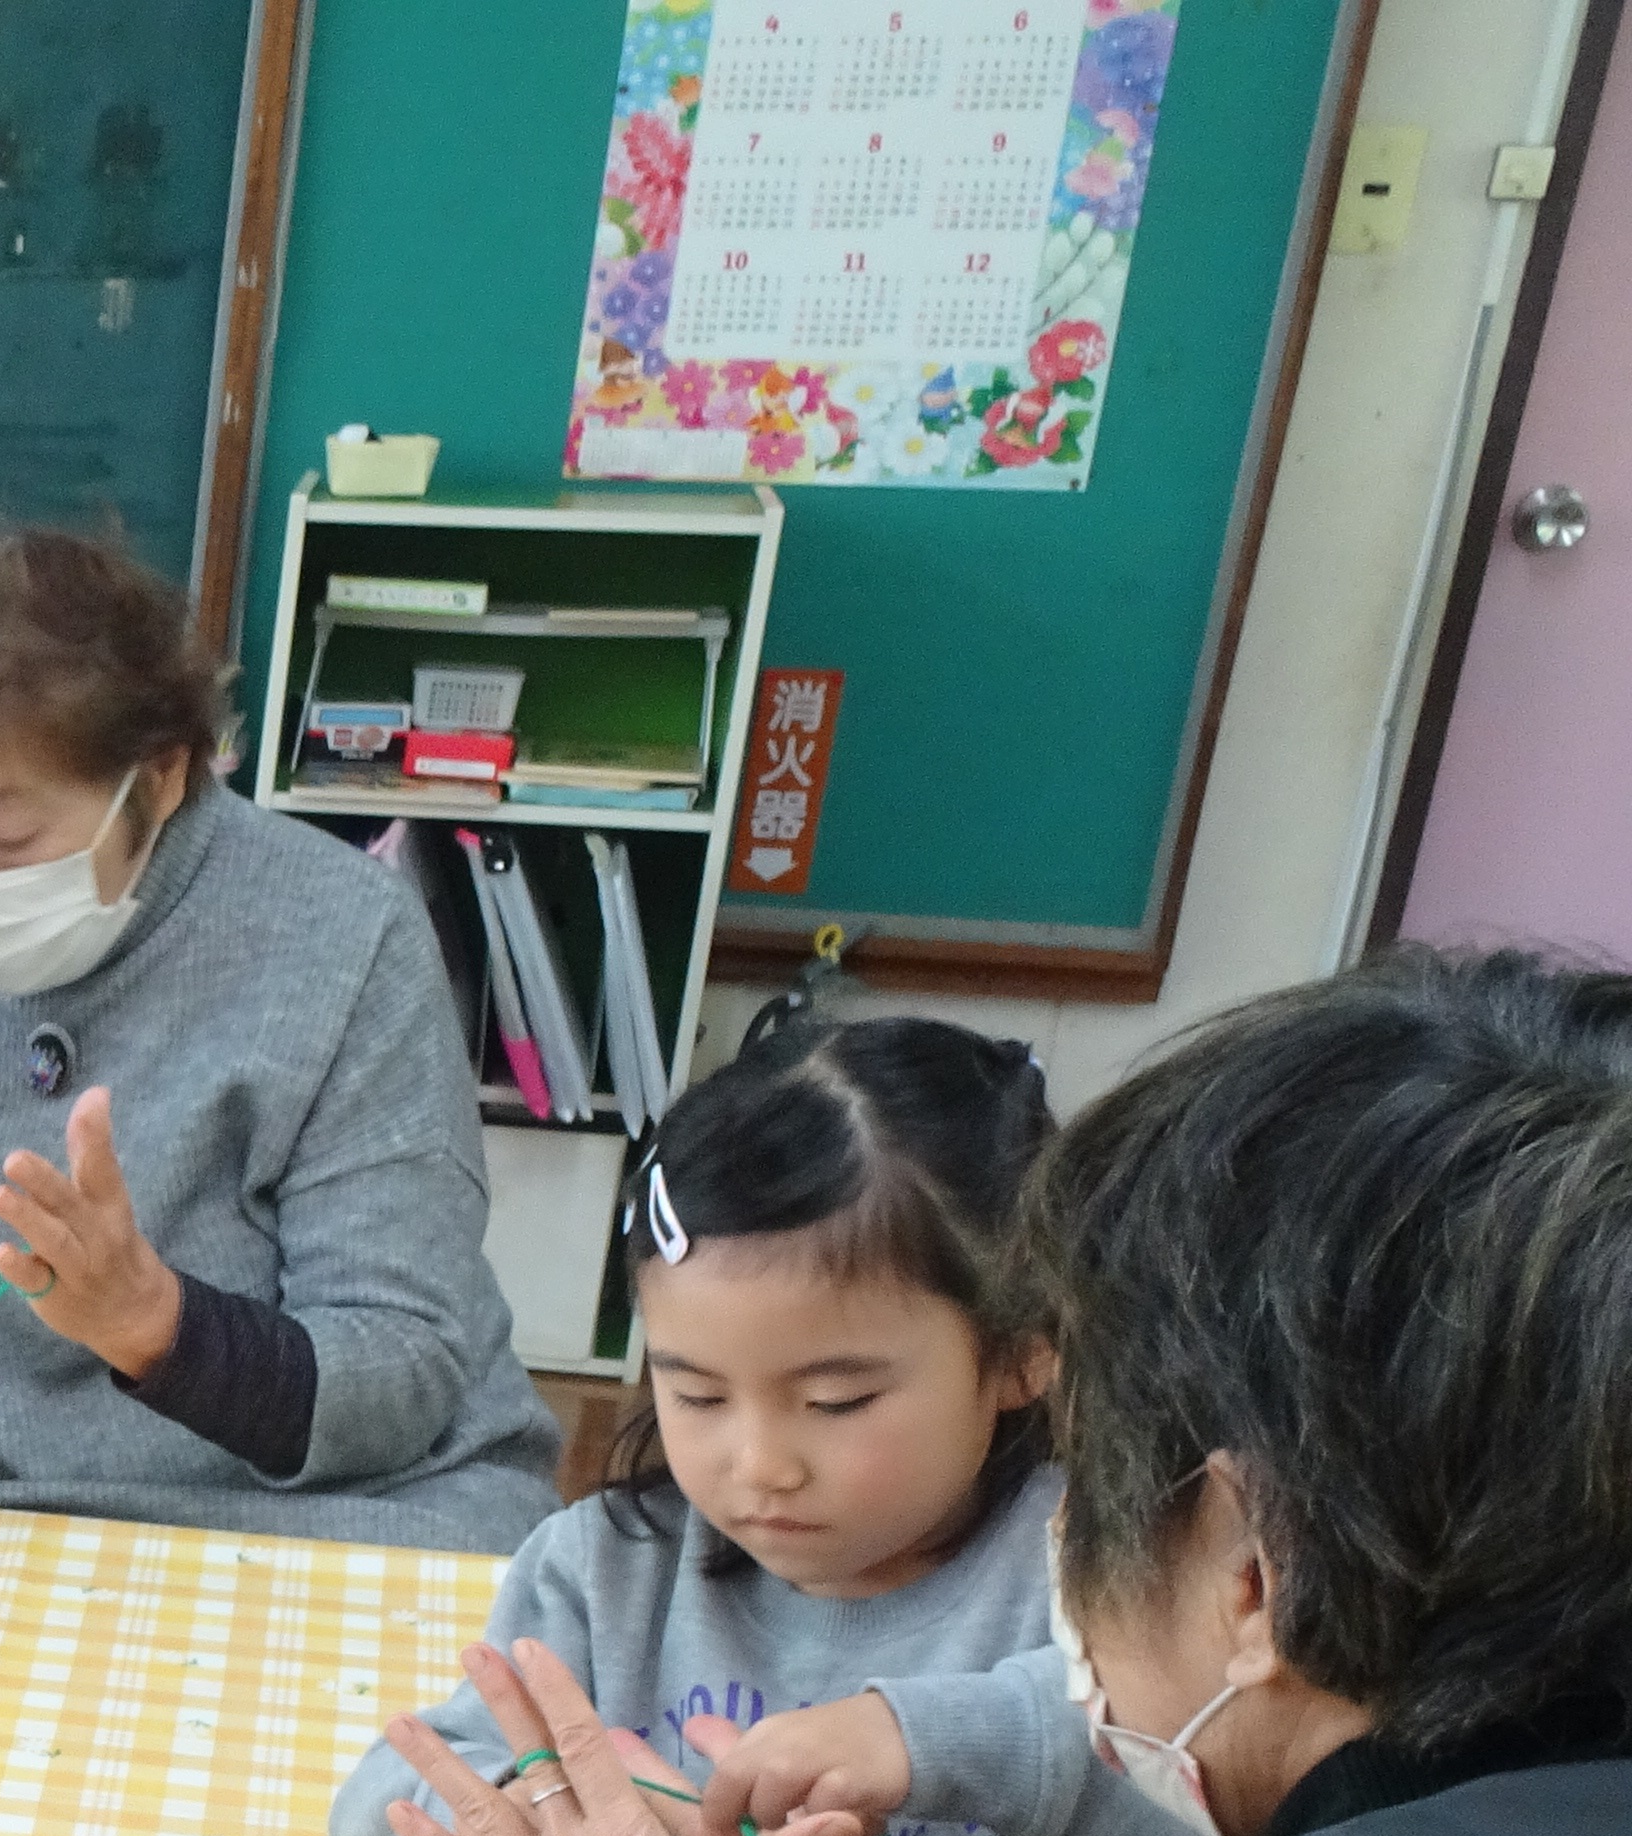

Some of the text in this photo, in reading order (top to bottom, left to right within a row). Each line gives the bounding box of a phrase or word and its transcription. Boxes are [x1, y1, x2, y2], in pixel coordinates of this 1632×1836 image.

[765, 15, 780, 33] 4
[888, 10, 903, 33] 5
[1013, 10, 1029, 32] 6
[748, 132, 761, 152] 7
[867, 132, 883, 153] 8
[991, 132, 1007, 152] 9
[722, 251, 750, 272] 10
[842, 251, 866, 273] 11
[963, 252, 992, 273] 12
[751, 679, 828, 840] 消火器
